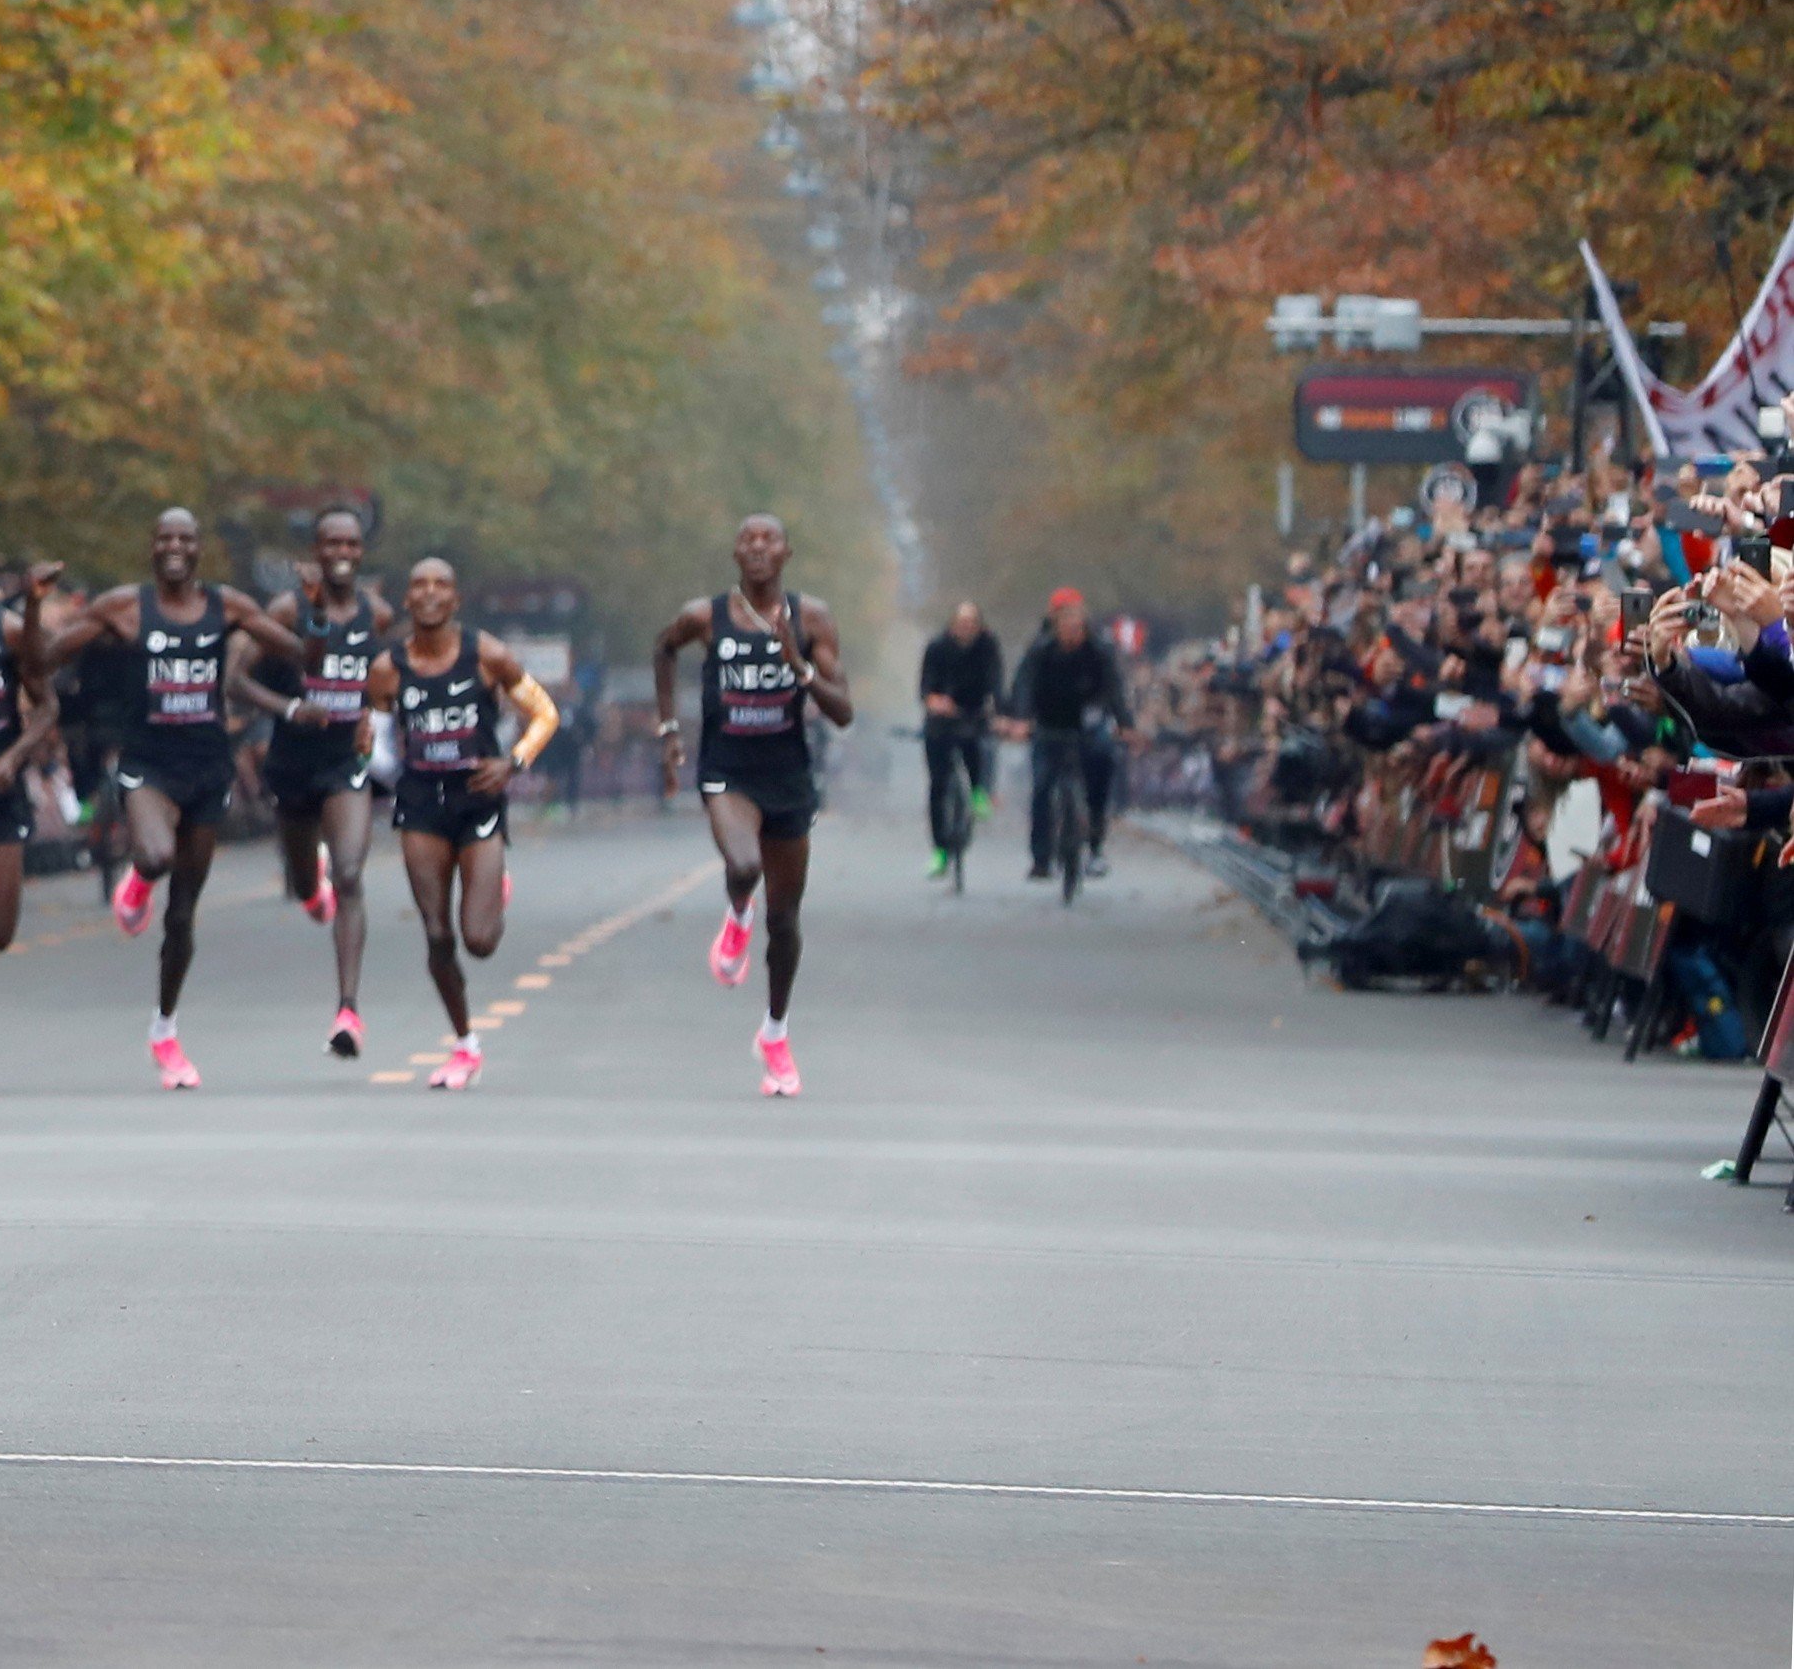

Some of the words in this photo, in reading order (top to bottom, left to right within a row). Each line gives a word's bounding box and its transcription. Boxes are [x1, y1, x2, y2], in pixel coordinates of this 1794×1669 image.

[147, 657, 218, 684] INEOS
[719, 662, 796, 691] INEOS
[407, 703, 480, 734] INEOS
